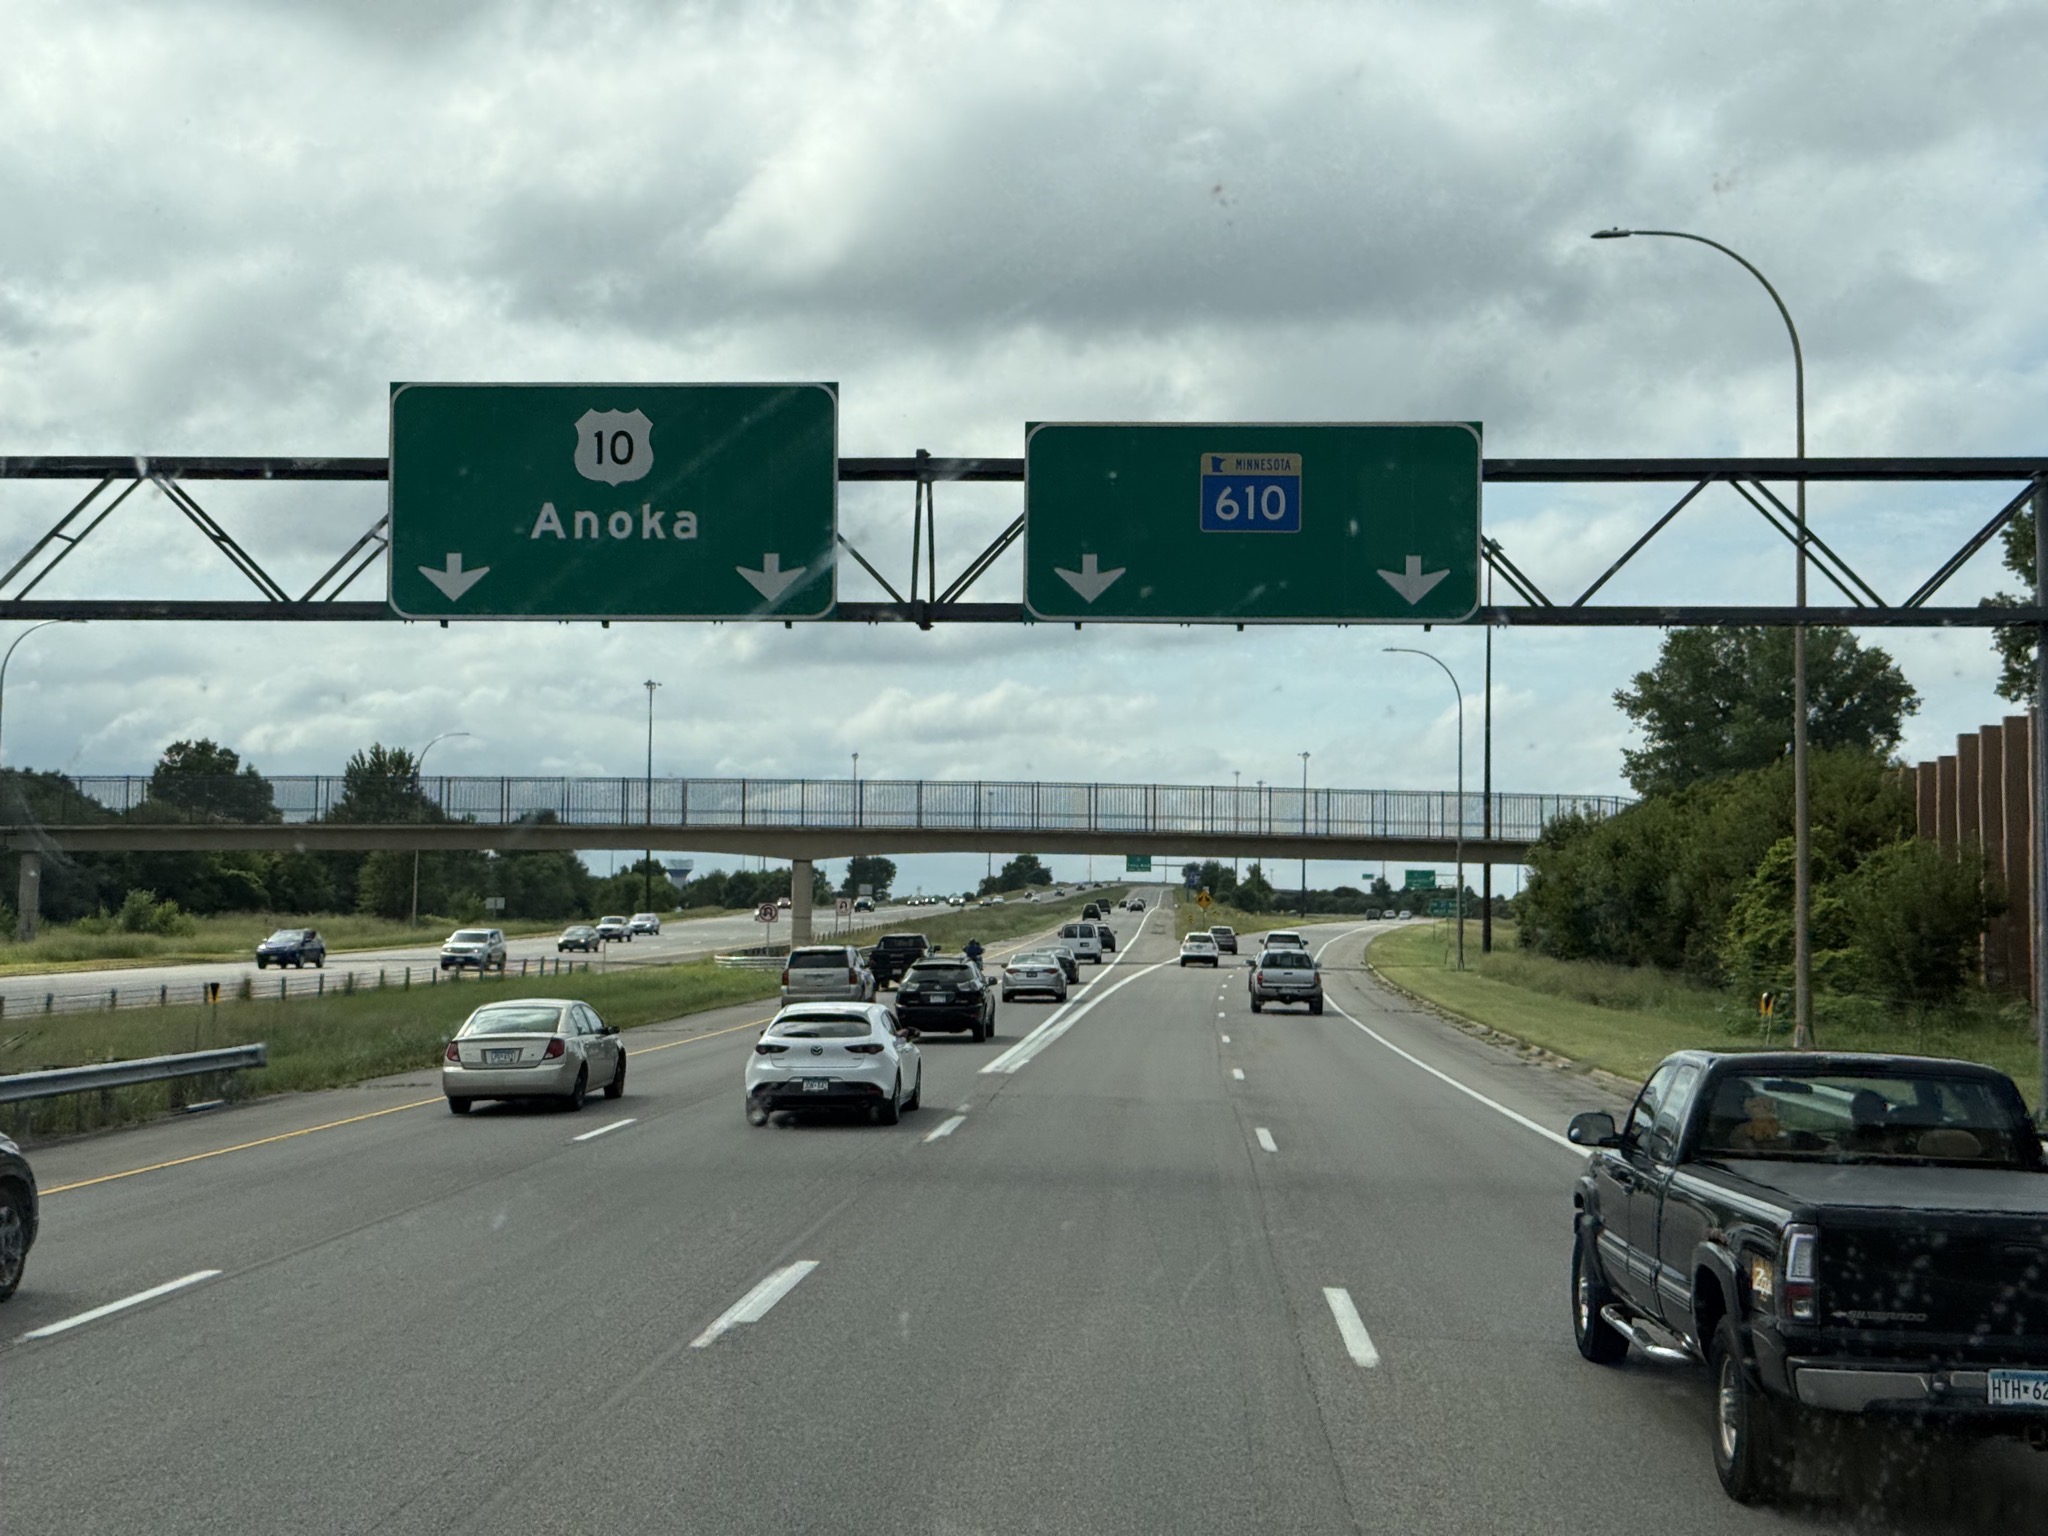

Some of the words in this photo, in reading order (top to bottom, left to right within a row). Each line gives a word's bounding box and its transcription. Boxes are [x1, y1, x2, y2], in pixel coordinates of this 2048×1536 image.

[594, 430, 634, 465] 10
[1235, 458, 1291, 471] MINNESOTA
[1215, 485, 1286, 521] 610
[530, 502, 698, 540] Anoka
